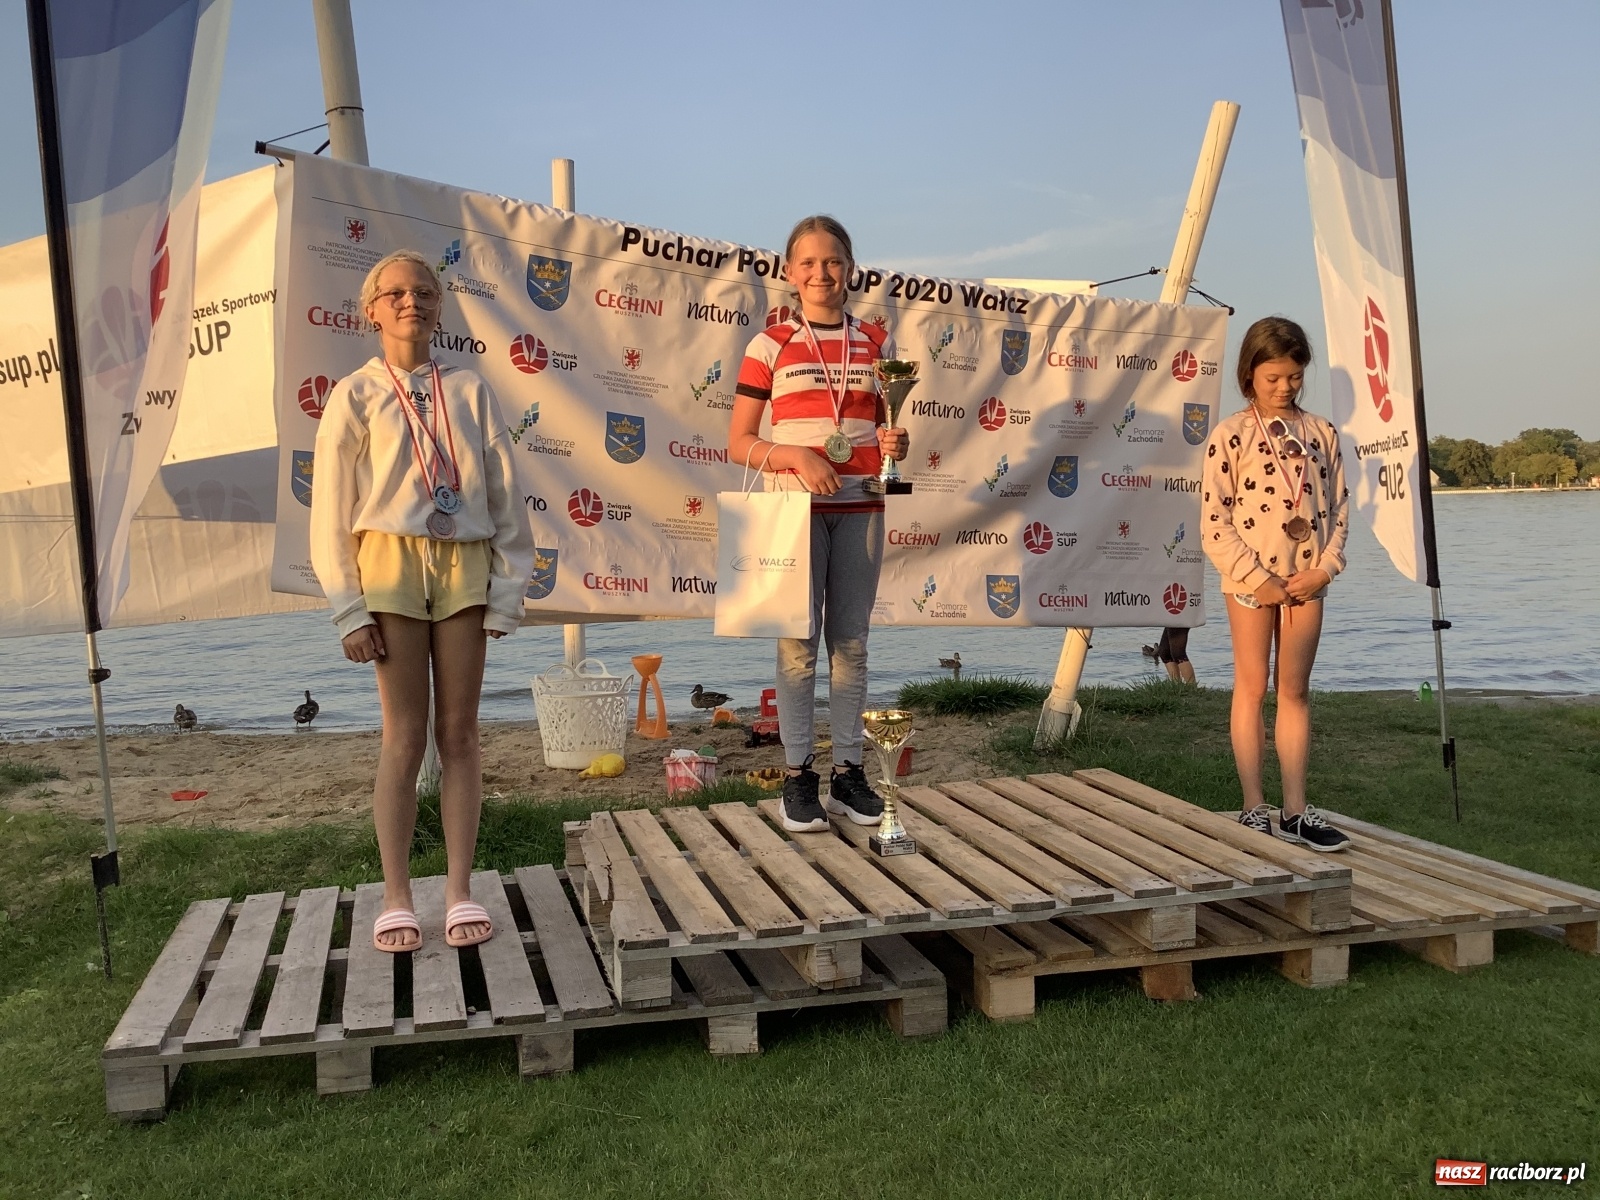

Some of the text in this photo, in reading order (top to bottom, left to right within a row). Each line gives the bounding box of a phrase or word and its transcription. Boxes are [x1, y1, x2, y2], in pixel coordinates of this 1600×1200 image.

[620, 226, 1030, 315] Puchar Pols UP 2020 Wałcz
[457, 273, 498, 291] Pomorze
[446, 281, 496, 300] Zachodnie
[222, 288, 277, 314] Sportowy
[594, 288, 664, 317] CECHINI
[551, 350, 578, 360] Związek
[949, 353, 979, 364] Pomorze
[1047, 352, 1098, 370] CECHINI
[552, 358, 578, 372] SUP
[942, 360, 977, 372] Zachodnie
[1200, 366, 1218, 376] SUP
[785, 368, 831, 379] RACIBORSKE
[707, 399, 734, 410] Zacho
[1009, 415, 1031, 425] SUP
[1133, 427, 1165, 436] Pomorze
[535, 434, 575, 448] Pomorze
[1127, 435, 1164, 443] Zachodnie
[527, 442, 572, 457] Zachodnie
[668, 440, 728, 464] CECHINI
[1101, 472, 1152, 488] CECHINI
[607, 502, 632, 511] Związek
[607, 510, 632, 522] SUP
[888, 529, 941, 546] CECHINI
[1057, 537, 1077, 547] SUP
[758, 557, 797, 567] WAŁCZ
[583, 572, 649, 593] CECHINI
[936, 602, 968, 611] Pomorze
[1038, 593, 1088, 608] CECHINI
[930, 610, 967, 618] Zachodnie
